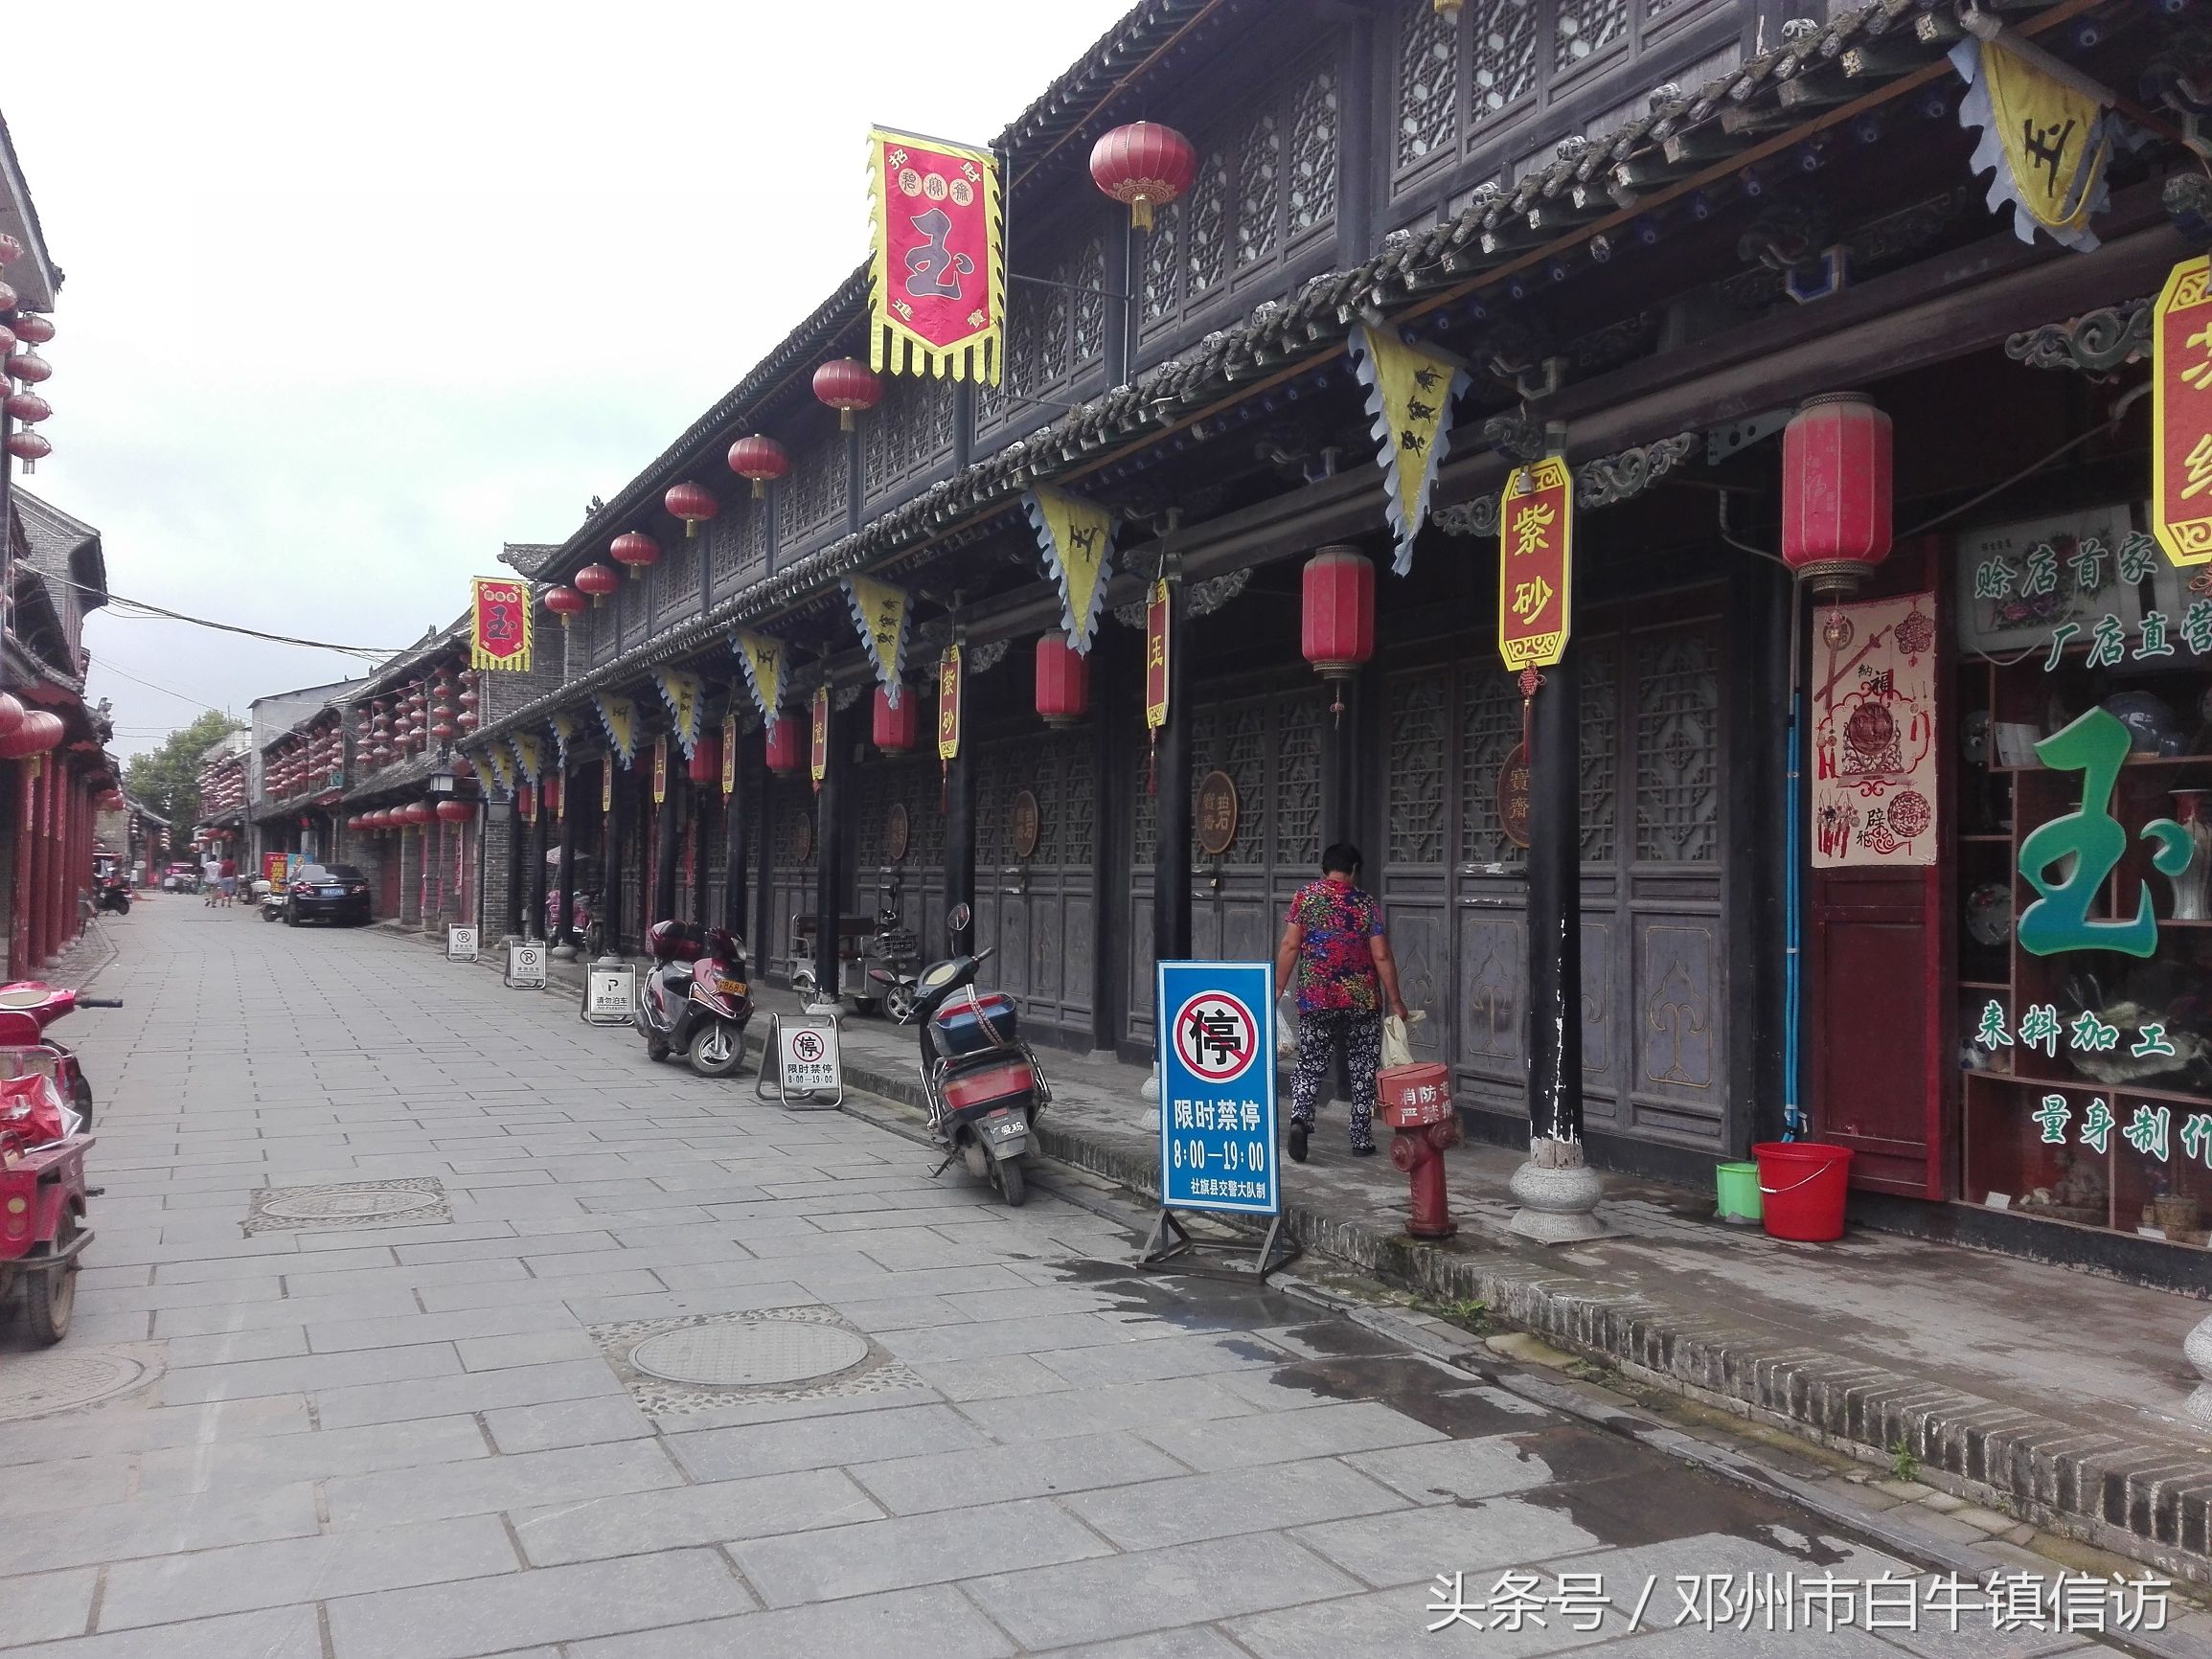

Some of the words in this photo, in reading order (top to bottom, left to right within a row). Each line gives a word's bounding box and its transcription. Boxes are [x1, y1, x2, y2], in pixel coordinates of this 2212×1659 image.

[2024, 118, 2076, 199] 玉
[904, 207, 975, 300] 玉
[1513, 502, 1557, 625] 紫砂
[1974, 531, 2158, 600] 赊店首家
[487, 604, 517, 640] 玉
[2044, 599, 2212, 672] 厂店直营
[943, 669, 955, 736] 紫砂
[2017, 705, 2196, 959] 玉
[800, 1036, 817, 1057] 停
[1189, 1009, 1241, 1065] 停
[1975, 999, 2176, 1058] 来料加工
[787, 1064, 832, 1073] 限时禁停
[1174, 1100, 1261, 1132] 限时禁停
[2031, 1094, 2212, 1170] 量身制作
[1191, 1178, 1266, 1199] 社旗县交警大队制
